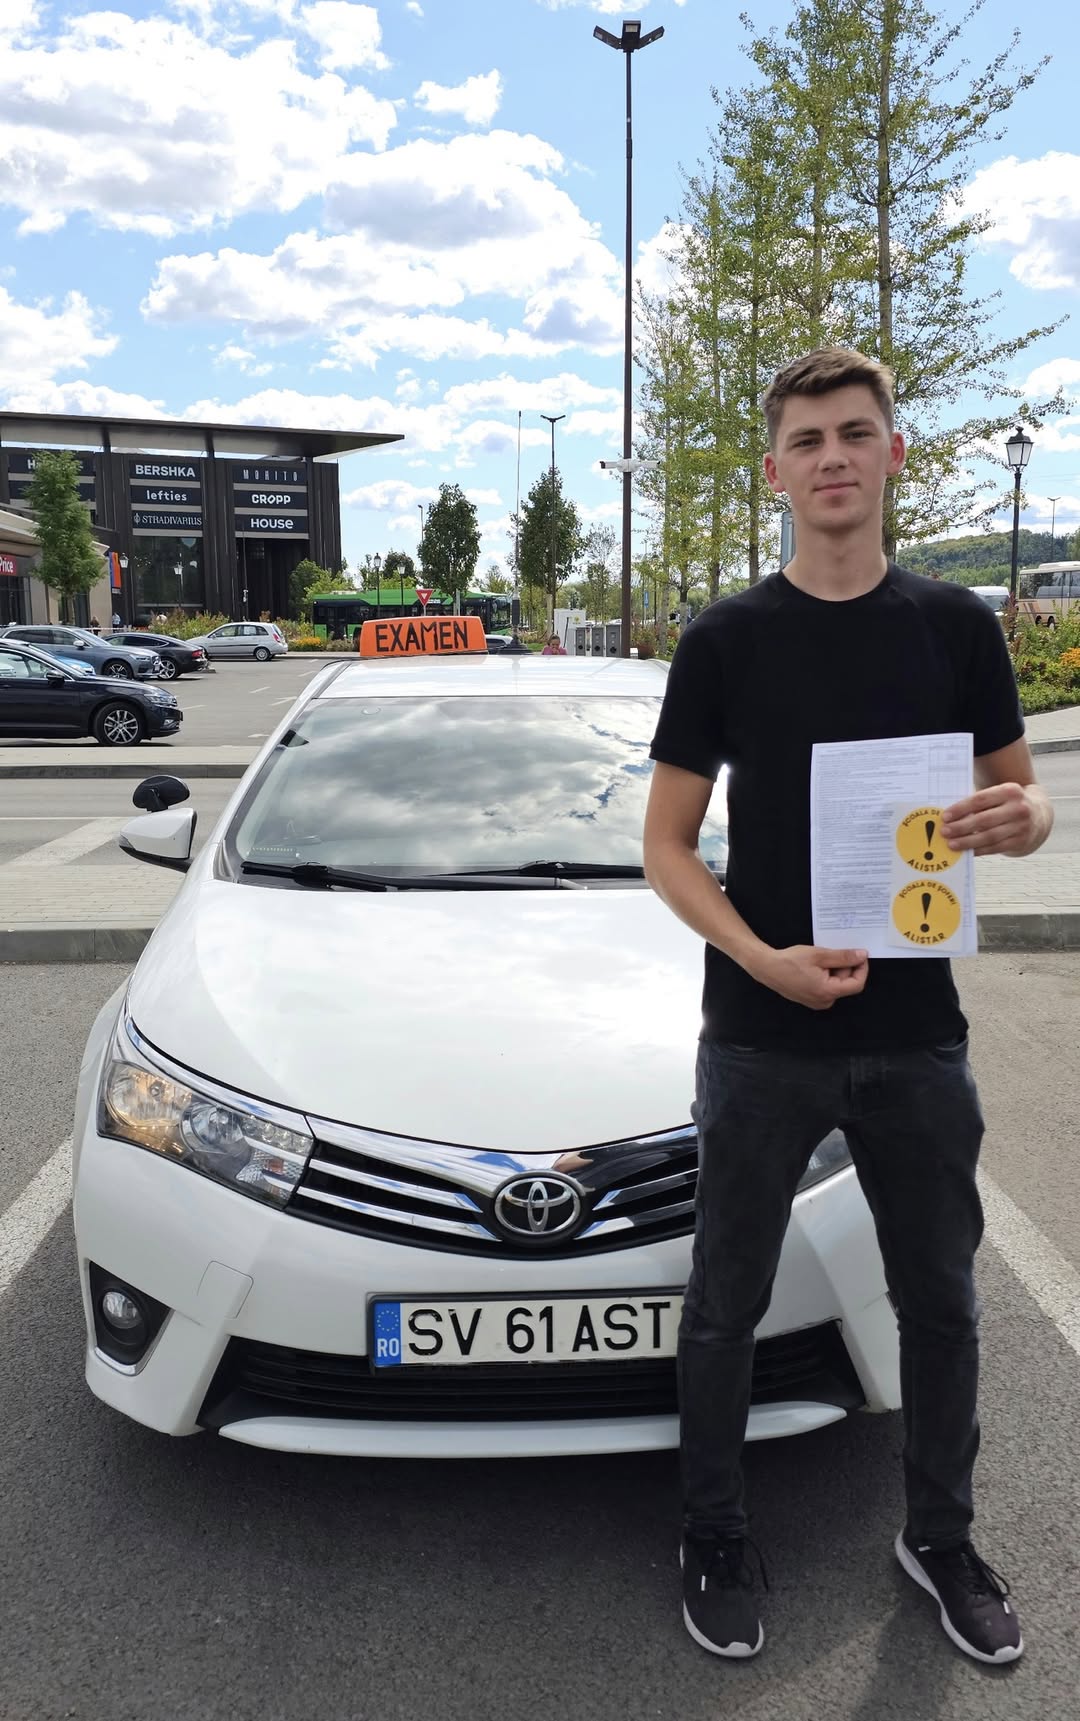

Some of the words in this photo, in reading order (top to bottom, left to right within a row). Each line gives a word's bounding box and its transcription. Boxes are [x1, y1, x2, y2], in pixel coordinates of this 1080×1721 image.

[135, 464, 196, 477] BERSHKA
[146, 489, 187, 501] lefties
[251, 494, 291, 505] CROPP
[142, 514, 202, 526] STRADIVARIUS
[375, 621, 468, 652] EXAMEN
[907, 859, 949, 872] ALISTAR
[903, 930, 946, 944] ALISTAR
[407, 1307, 482, 1356] SV
[505, 1305, 554, 1354] 61
[572, 1301, 671, 1352] AST
[376, 1337, 399, 1358] RO
